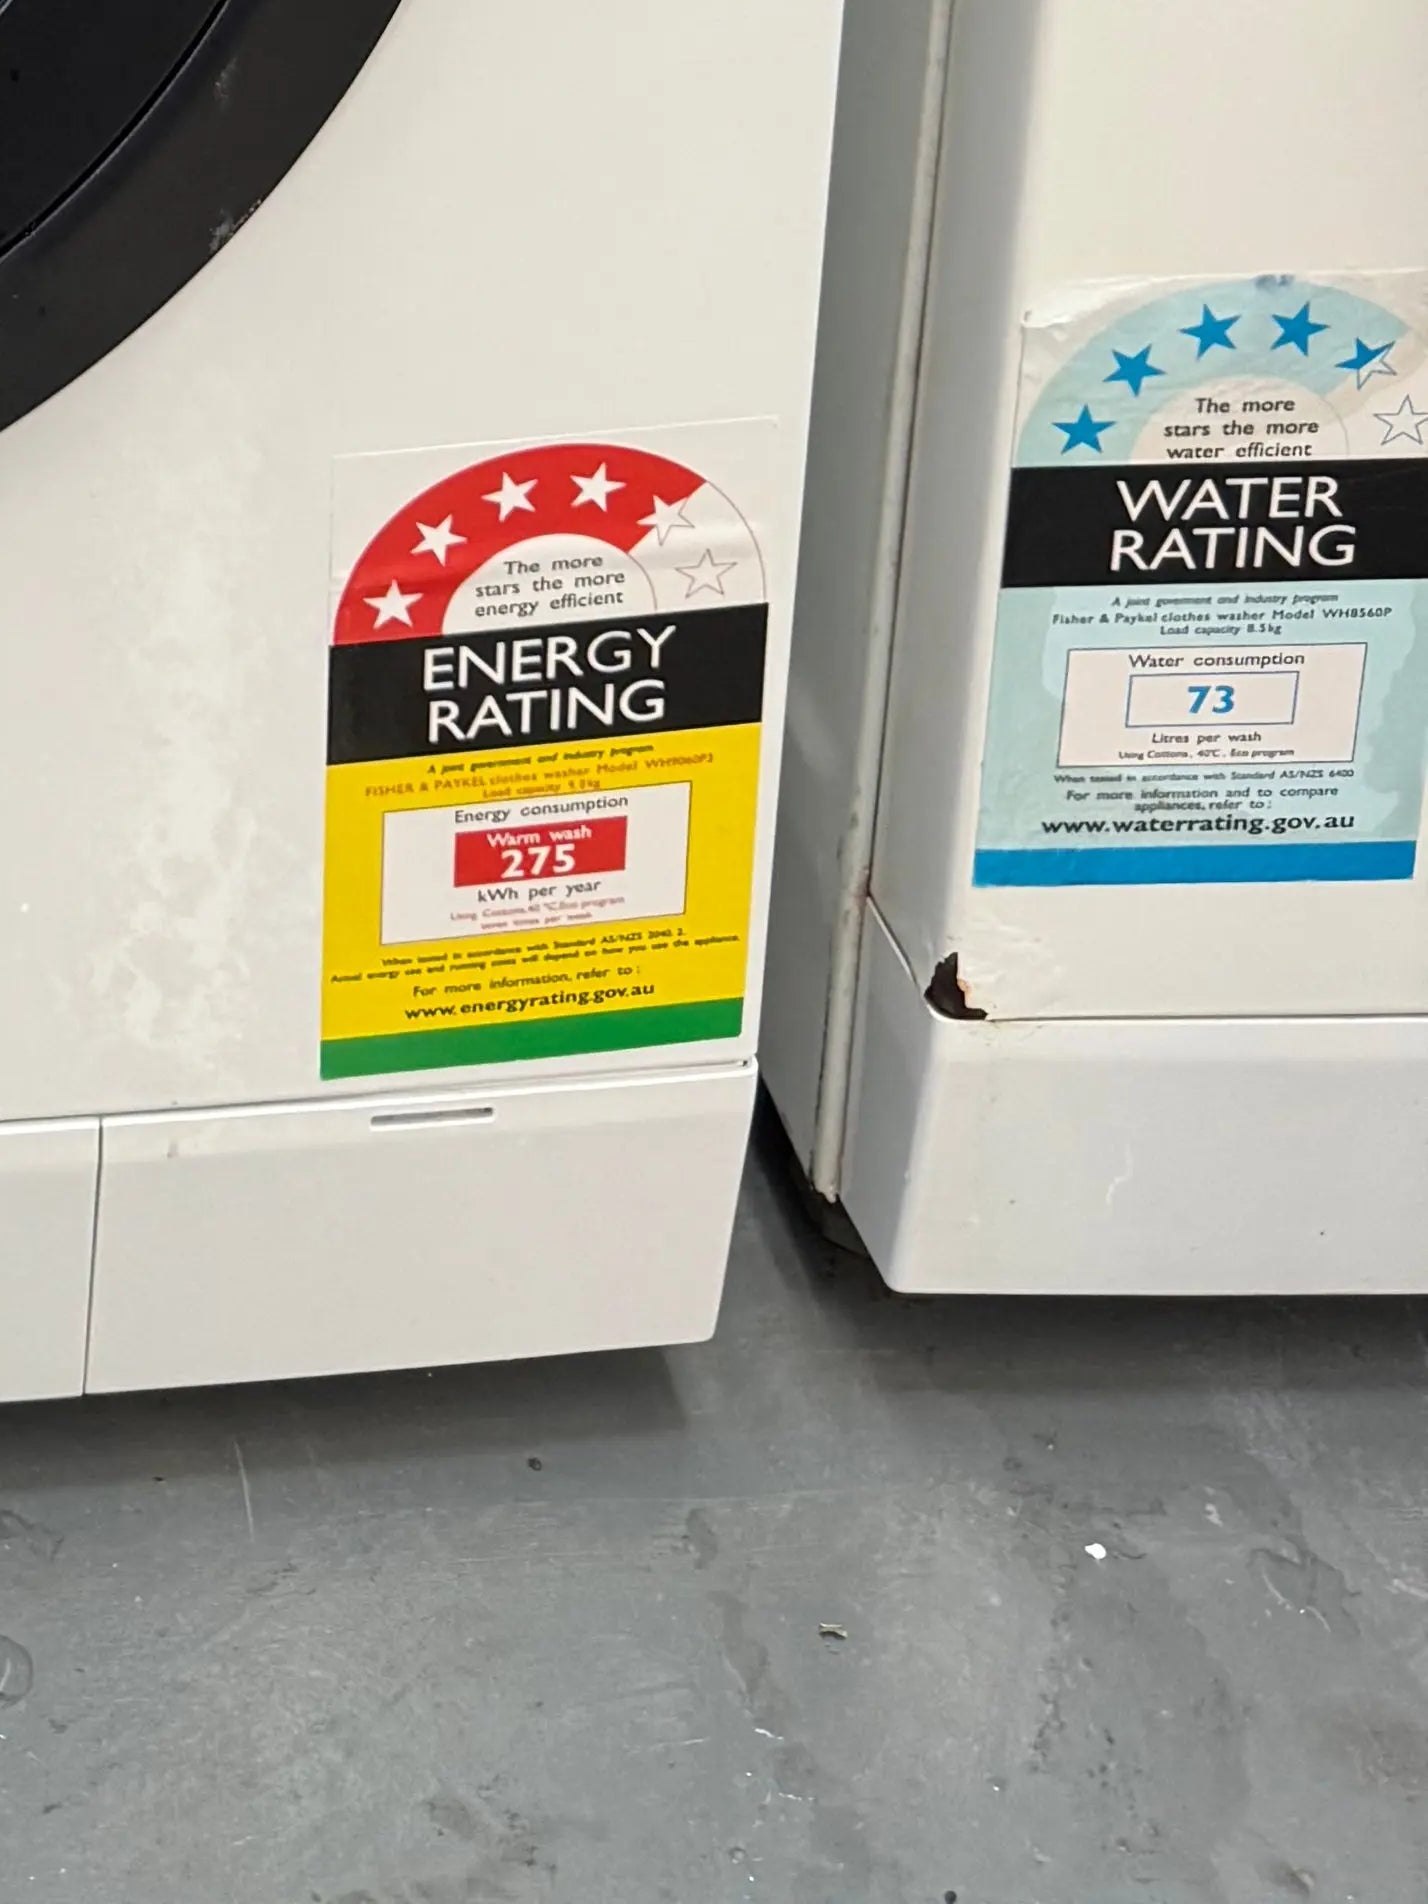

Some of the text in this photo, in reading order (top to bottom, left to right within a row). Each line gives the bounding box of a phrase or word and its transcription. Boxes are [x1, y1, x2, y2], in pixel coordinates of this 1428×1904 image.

[1196, 398, 1295, 413] The more
[1164, 420, 1319, 437] stars the more
[1167, 442, 1312, 458] water efficient
[1117, 476, 1342, 521] WATER
[1111, 525, 1355, 571] RATING
[504, 557, 602, 575] The more
[476, 573, 624, 597] stars the more
[475, 592, 623, 617] energy efficient
[423, 625, 675, 690] ENERGY
[1129, 653, 1304, 668] Water consumption
[429, 679, 665, 744] RATING
[1188, 686, 1234, 713] 73
[1152, 732, 1261, 745] Litres per wash
[455, 795, 628, 824] Energy consumption
[1042, 814, 1354, 834] www.waterrating.gov.au
[487, 825, 591, 849] Warm wash
[502, 845, 576, 879] 275
[478, 882, 600, 902] kWh per year
[405, 985, 655, 1021] www.energyrating.gov.au
